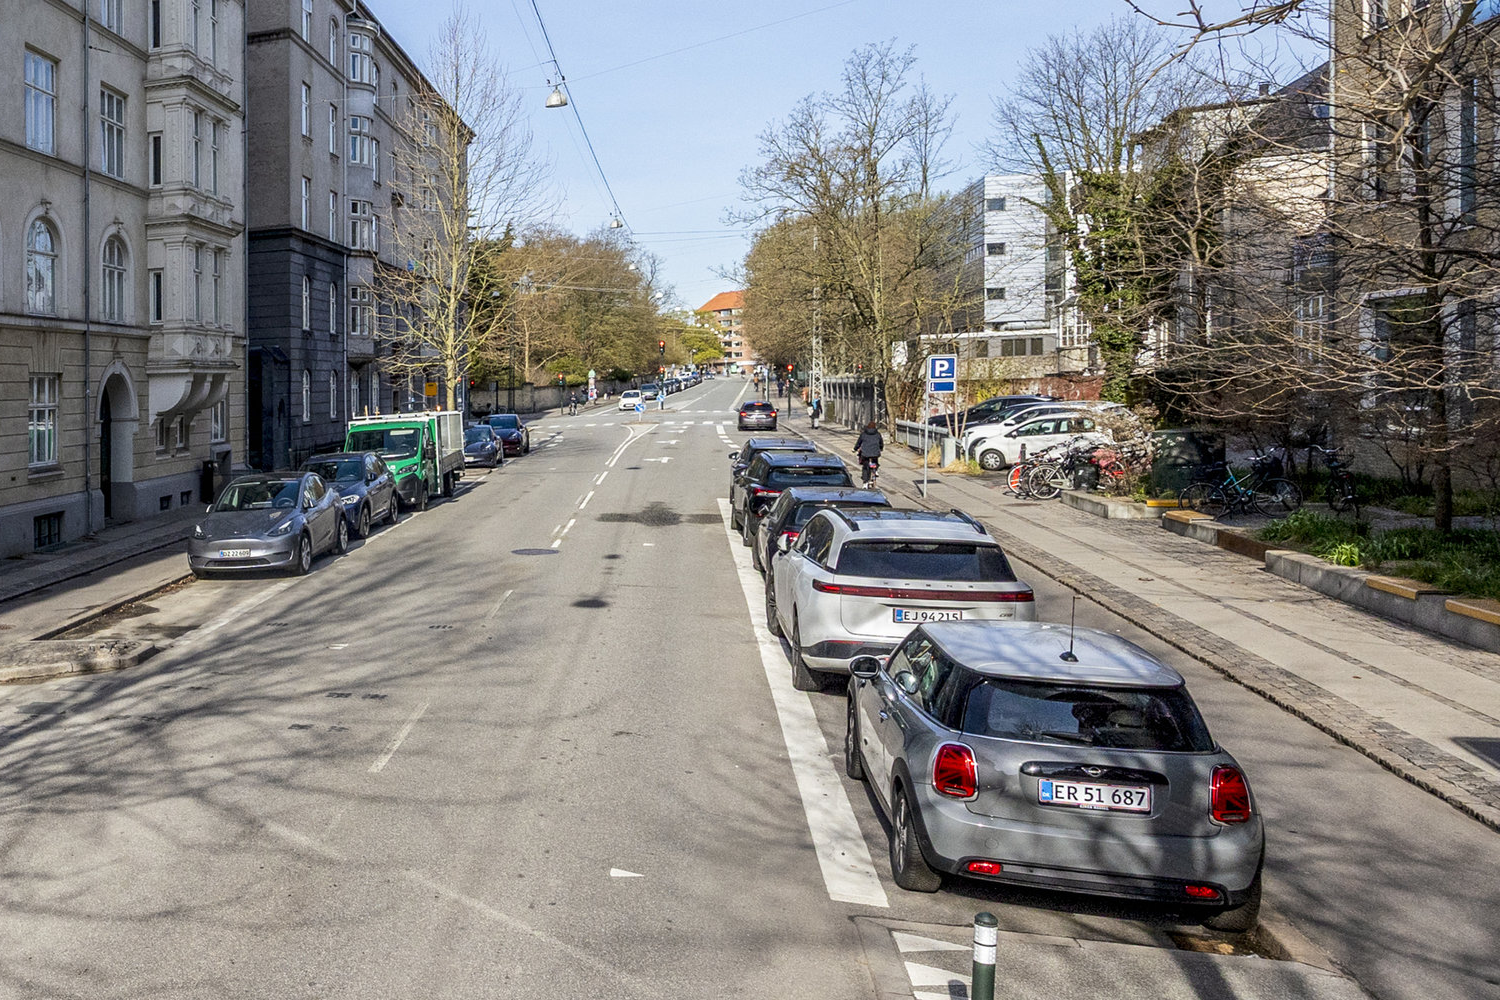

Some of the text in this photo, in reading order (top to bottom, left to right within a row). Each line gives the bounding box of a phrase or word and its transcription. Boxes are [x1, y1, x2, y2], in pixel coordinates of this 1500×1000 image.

[934, 360, 949, 377] P
[903, 610, 959, 622] EJ 94 215
[1055, 784, 1146, 806] ER 51 687
